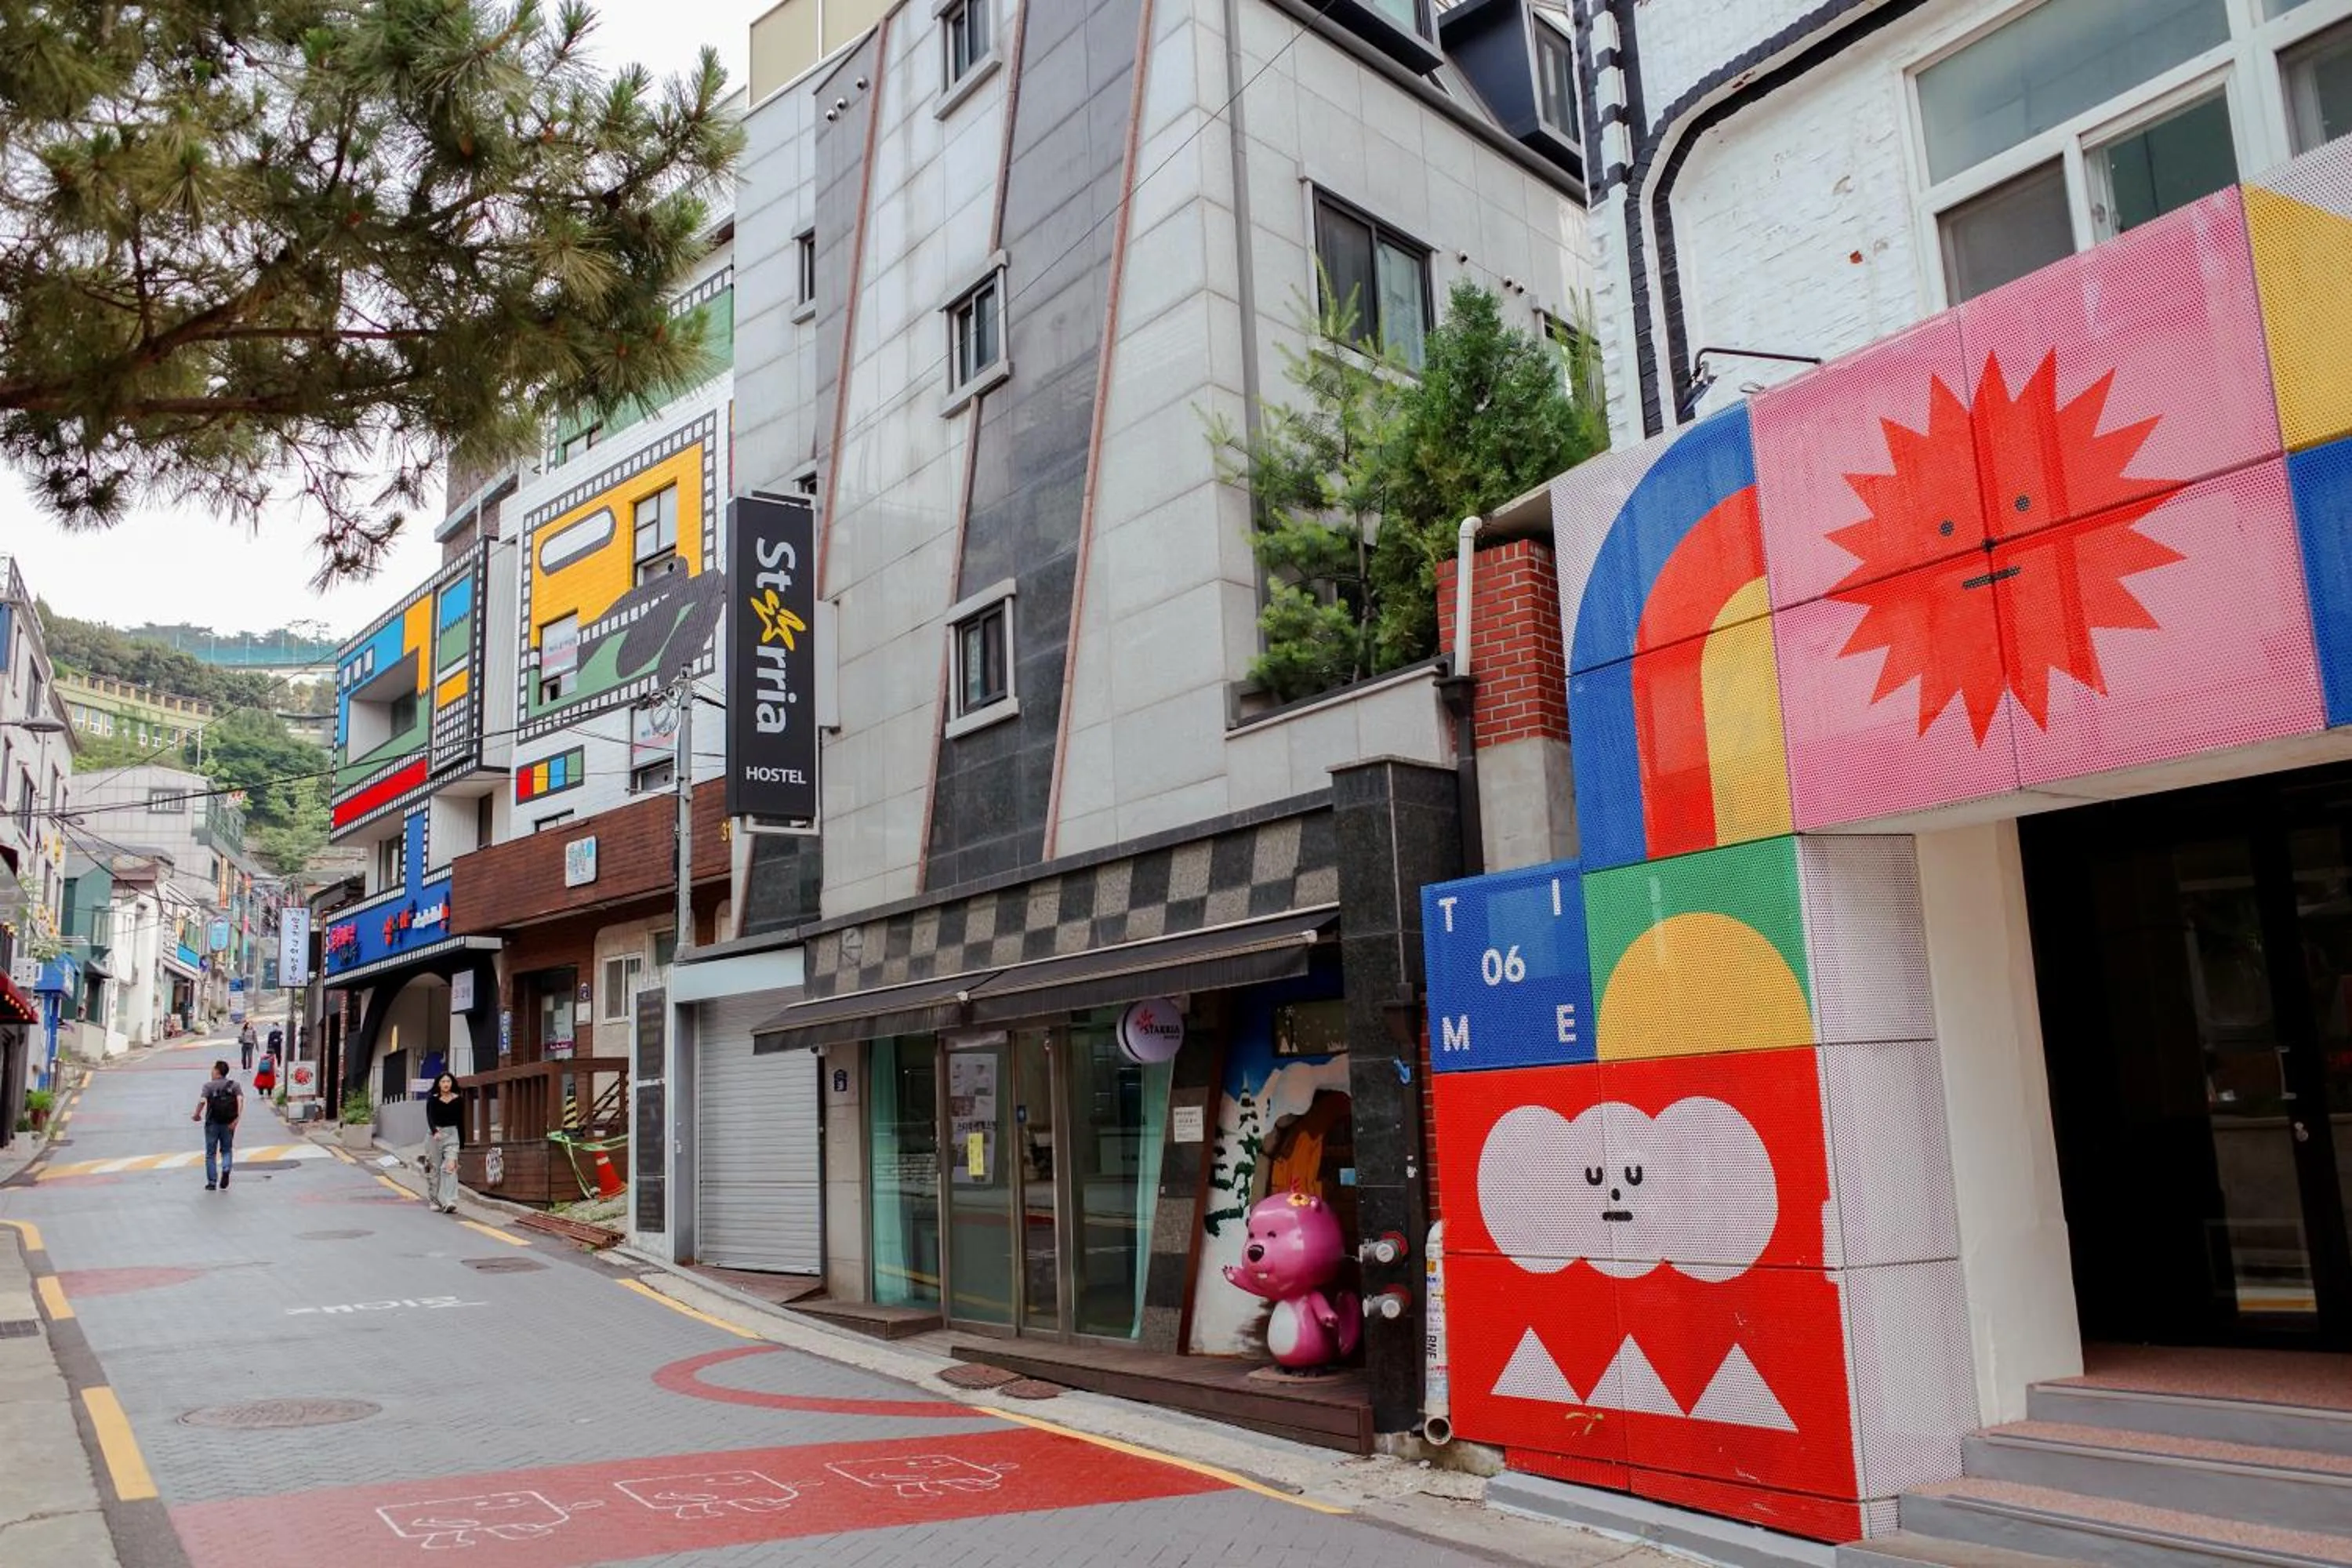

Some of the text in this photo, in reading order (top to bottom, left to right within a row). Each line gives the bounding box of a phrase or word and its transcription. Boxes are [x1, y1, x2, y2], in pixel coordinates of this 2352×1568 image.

[745, 766, 807, 785] HOSTEL
[1438, 896, 1458, 933] T
[1481, 944, 1526, 986] 06
[1442, 1004, 1577, 1052] M E
